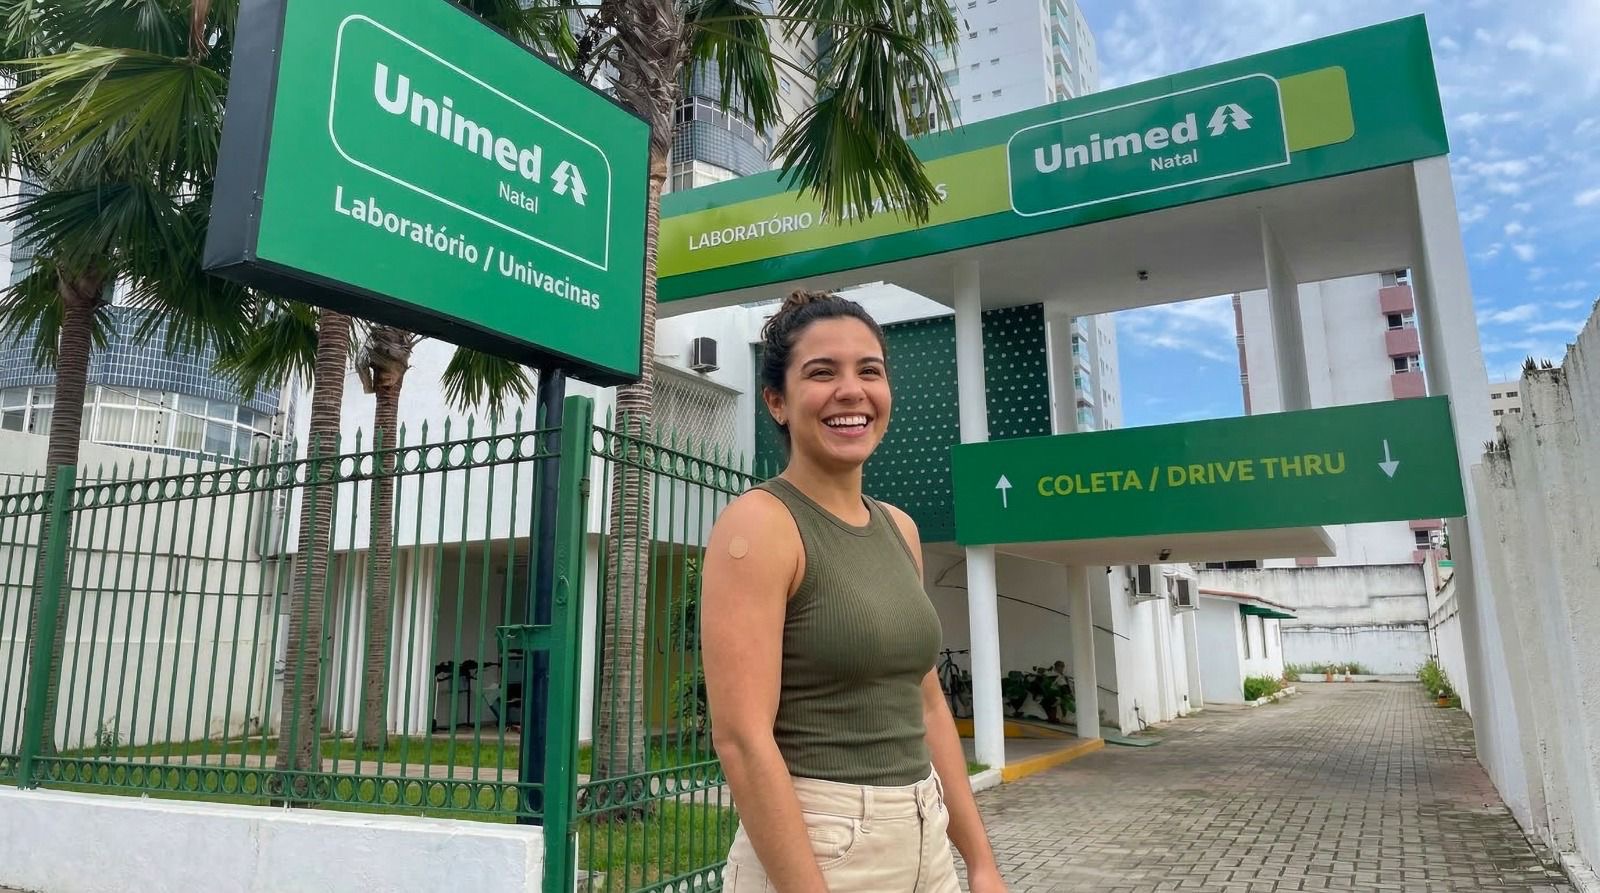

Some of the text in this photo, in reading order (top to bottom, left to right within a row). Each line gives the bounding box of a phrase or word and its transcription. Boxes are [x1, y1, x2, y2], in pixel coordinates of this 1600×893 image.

[374, 62, 542, 183] Unimed
[1034, 113, 1198, 174] Unimed
[1150, 149, 1198, 172] Natal
[499, 181, 538, 214] Natal
[334, 185, 601, 310] Laboratório / Univacinas
[689, 212, 812, 251] LABORATÓRIO
[1037, 452, 1346, 497] COLETA / DRIVE THRU
